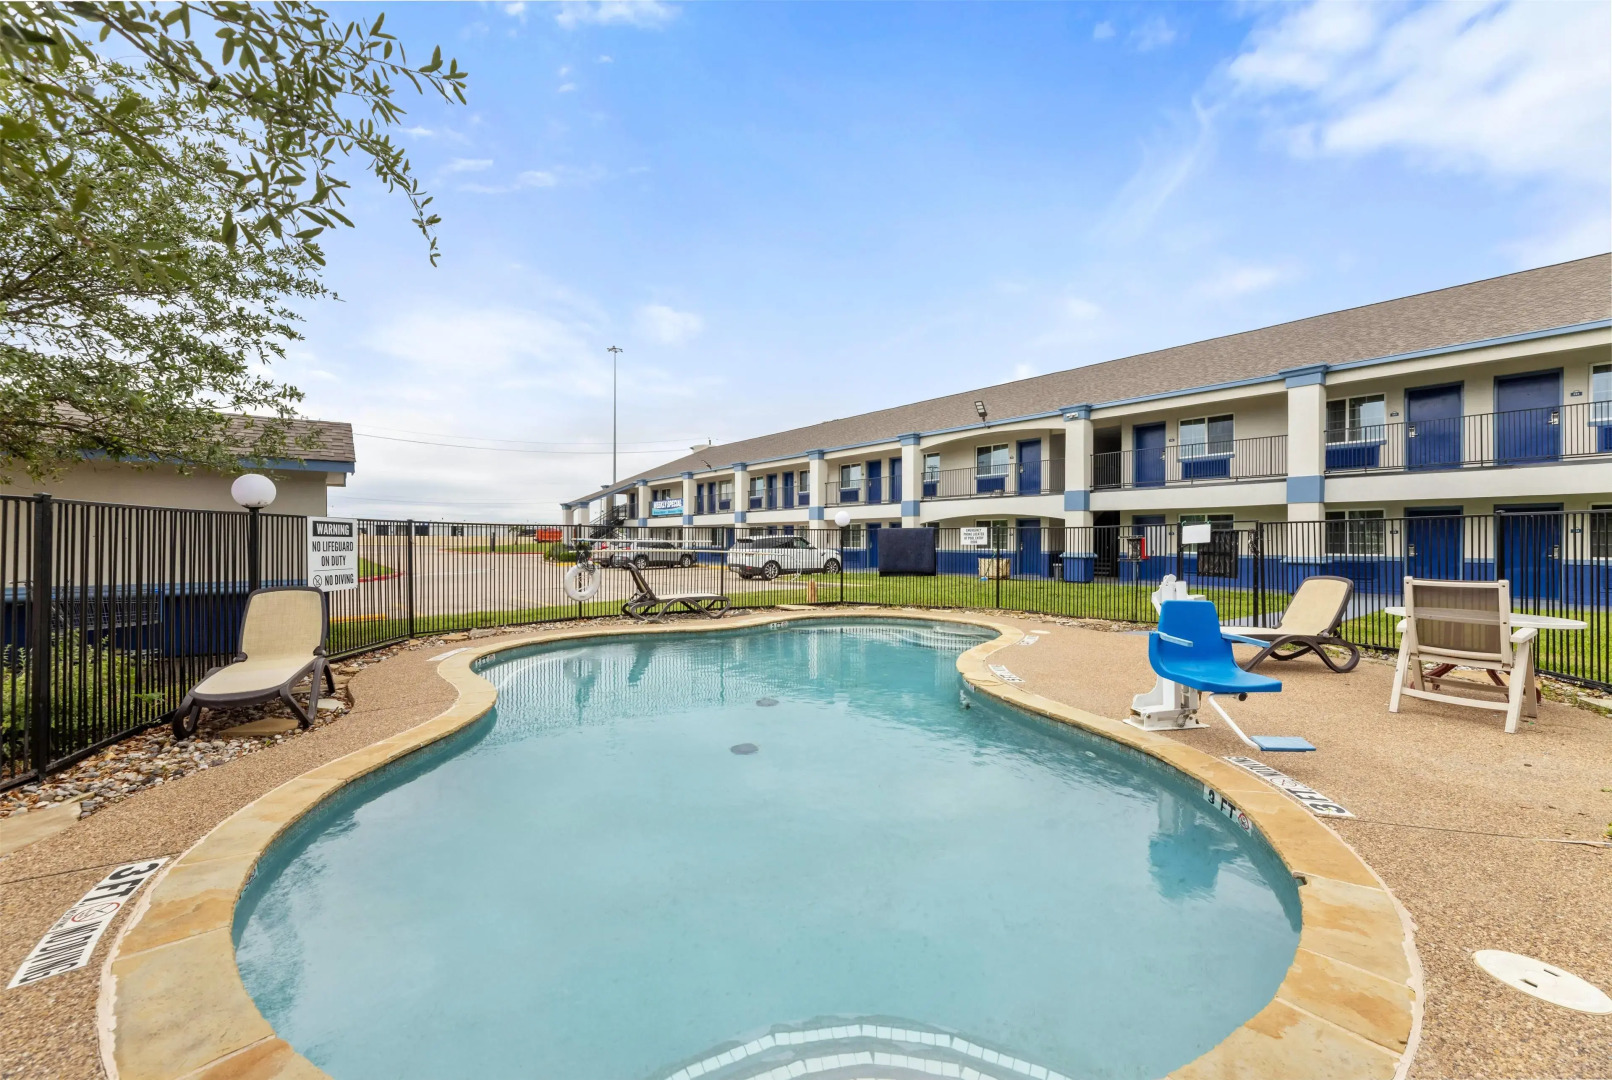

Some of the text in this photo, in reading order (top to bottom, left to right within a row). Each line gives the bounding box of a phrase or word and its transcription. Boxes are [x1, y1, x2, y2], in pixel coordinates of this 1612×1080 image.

[653, 501, 667, 509] WEEKLY
[316, 523, 350, 536] WARNING
[312, 541, 354, 552] NO LIFEGUARD
[321, 555, 346, 567] ON DUTY
[324, 573, 354, 586] NO DIVING
[1208, 789, 1215, 804] 3
[1309, 803, 1346, 813] 3
[108, 862, 160, 881] 3
[45, 921, 102, 944] NO
[18, 934, 93, 985] DIVING
